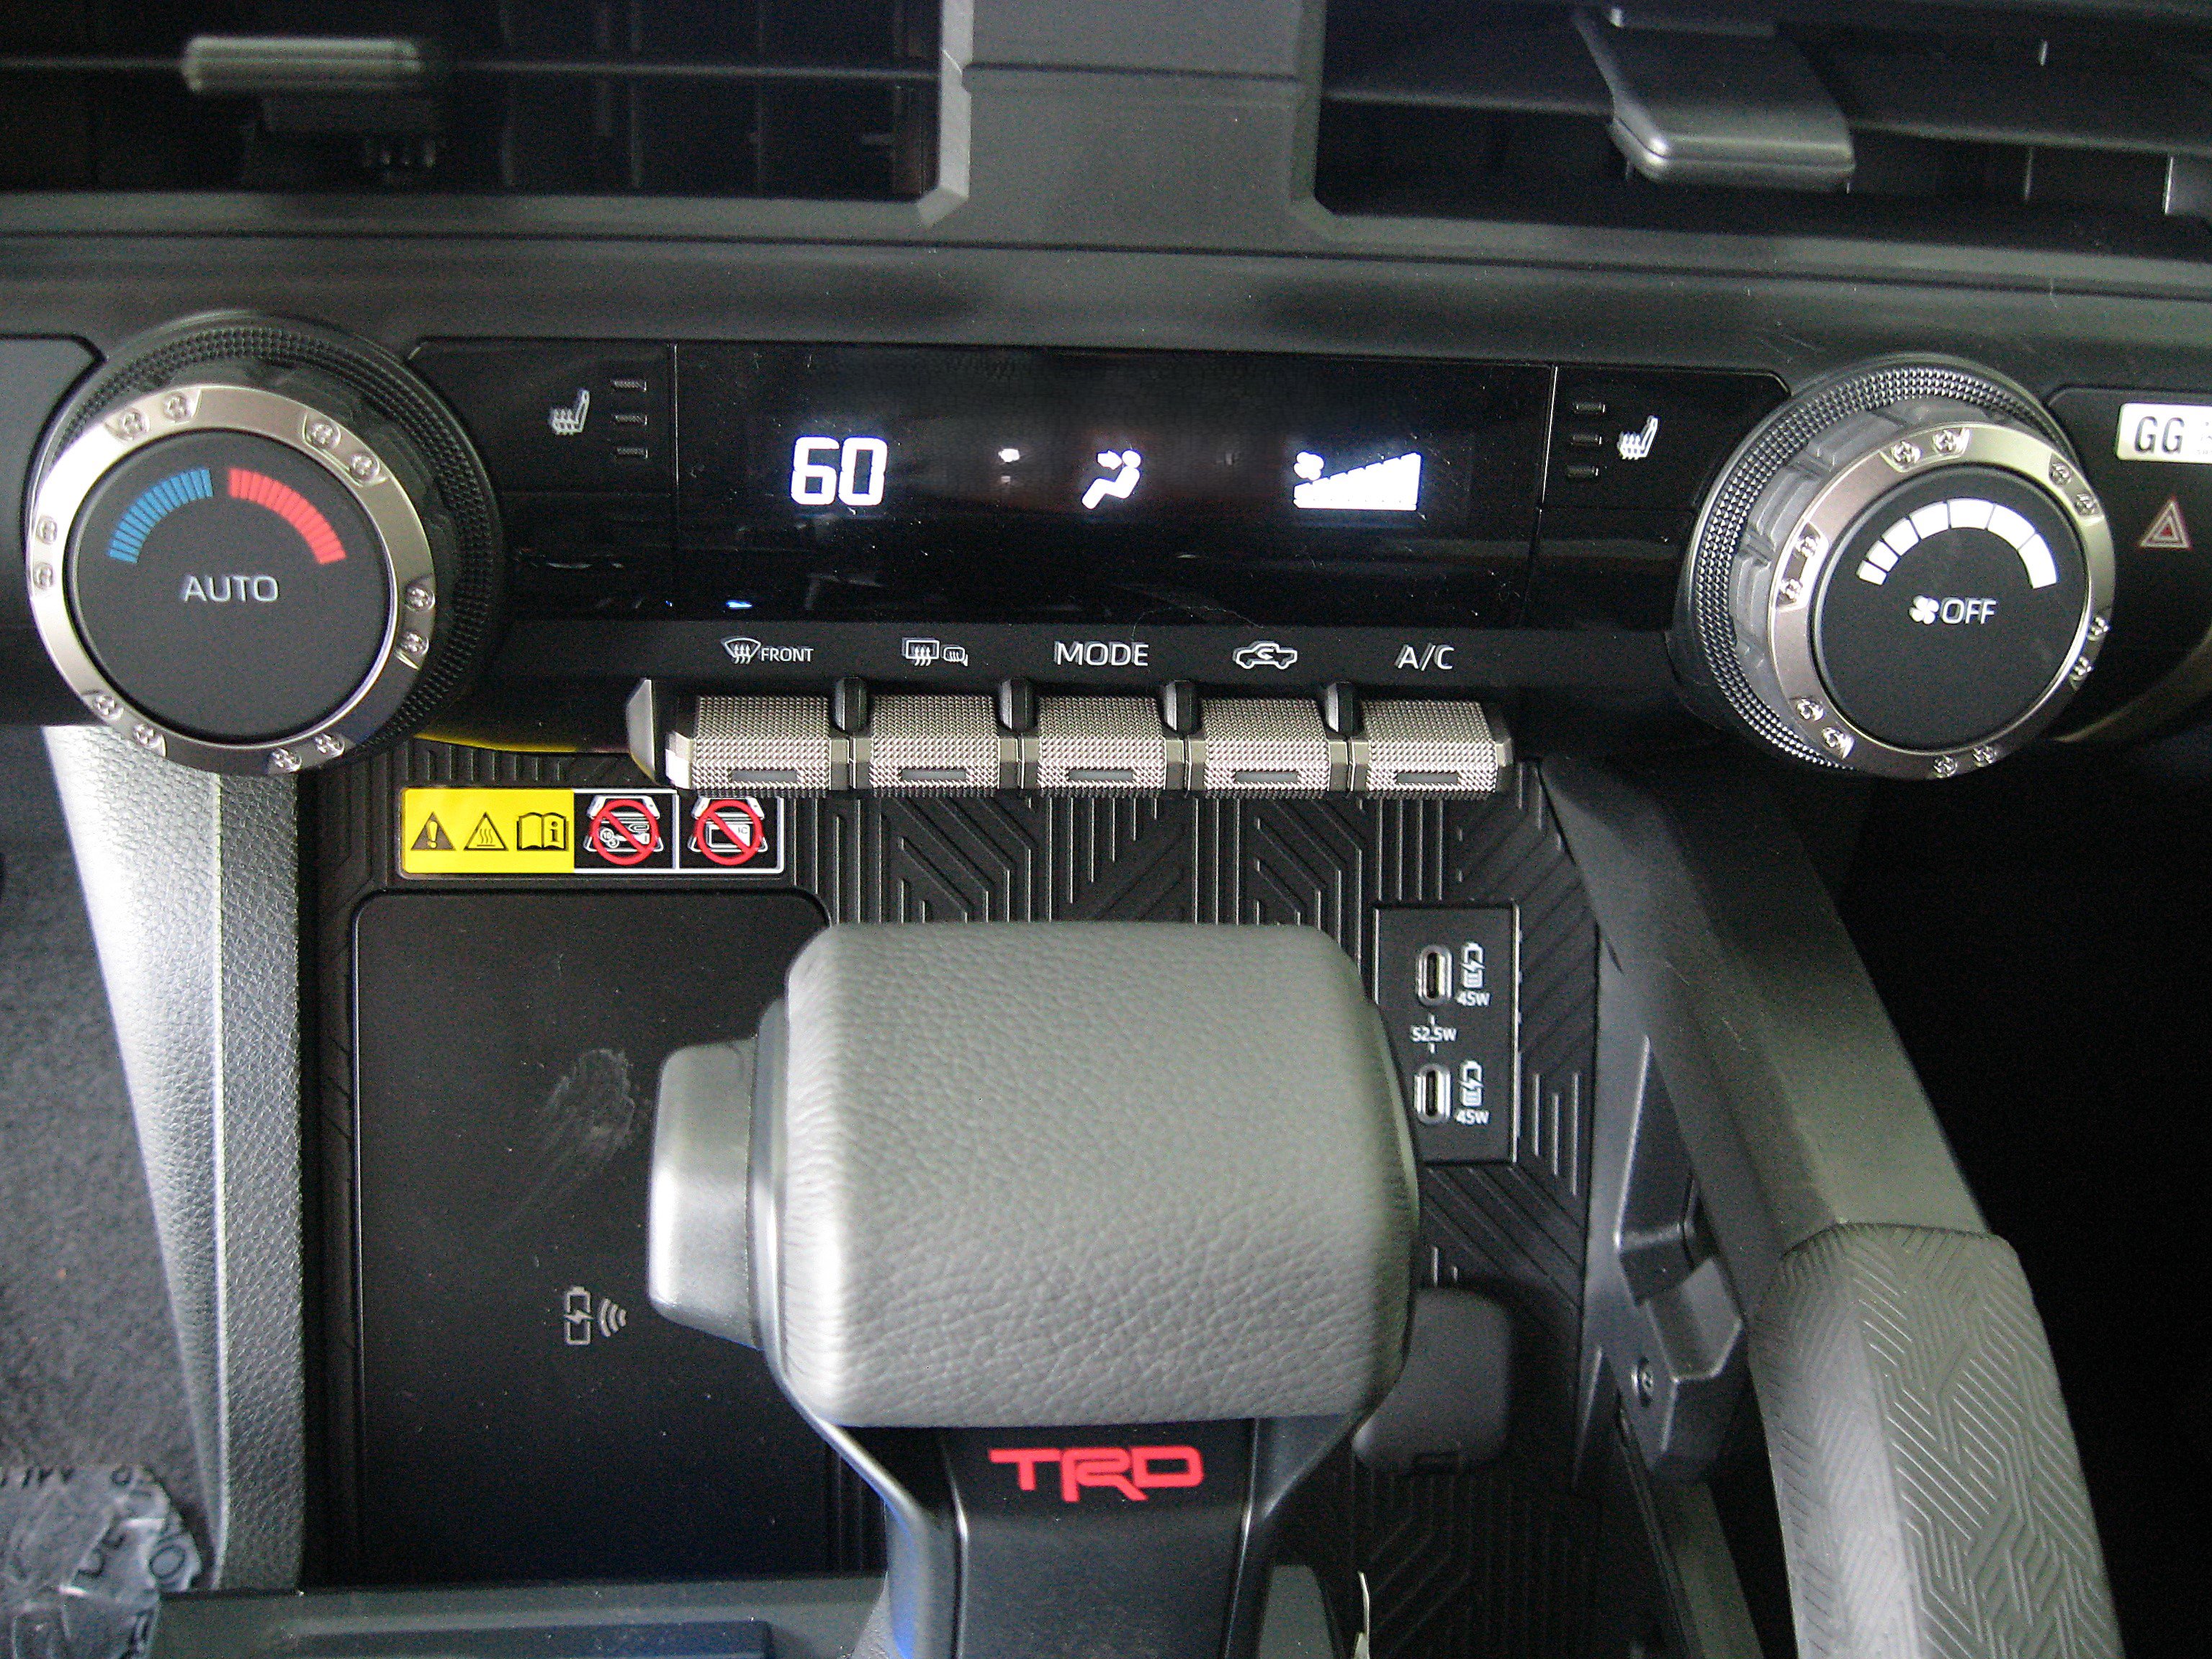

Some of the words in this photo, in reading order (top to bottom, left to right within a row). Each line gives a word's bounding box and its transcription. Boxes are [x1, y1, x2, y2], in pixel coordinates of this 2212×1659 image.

[790, 435, 888, 506] 60
[183, 575, 279, 603] AUTO
[1941, 598, 1997, 625] OFF
[760, 647, 814, 662] FRONT
[1054, 641, 1149, 667] MODE
[1395, 643, 1455, 671] A/C
[1456, 990, 1490, 1006] 45W
[1411, 1025, 1457, 1042] 52.5W
[1455, 1109, 1490, 1124] 45W
[987, 1444, 1204, 1502] TRD
